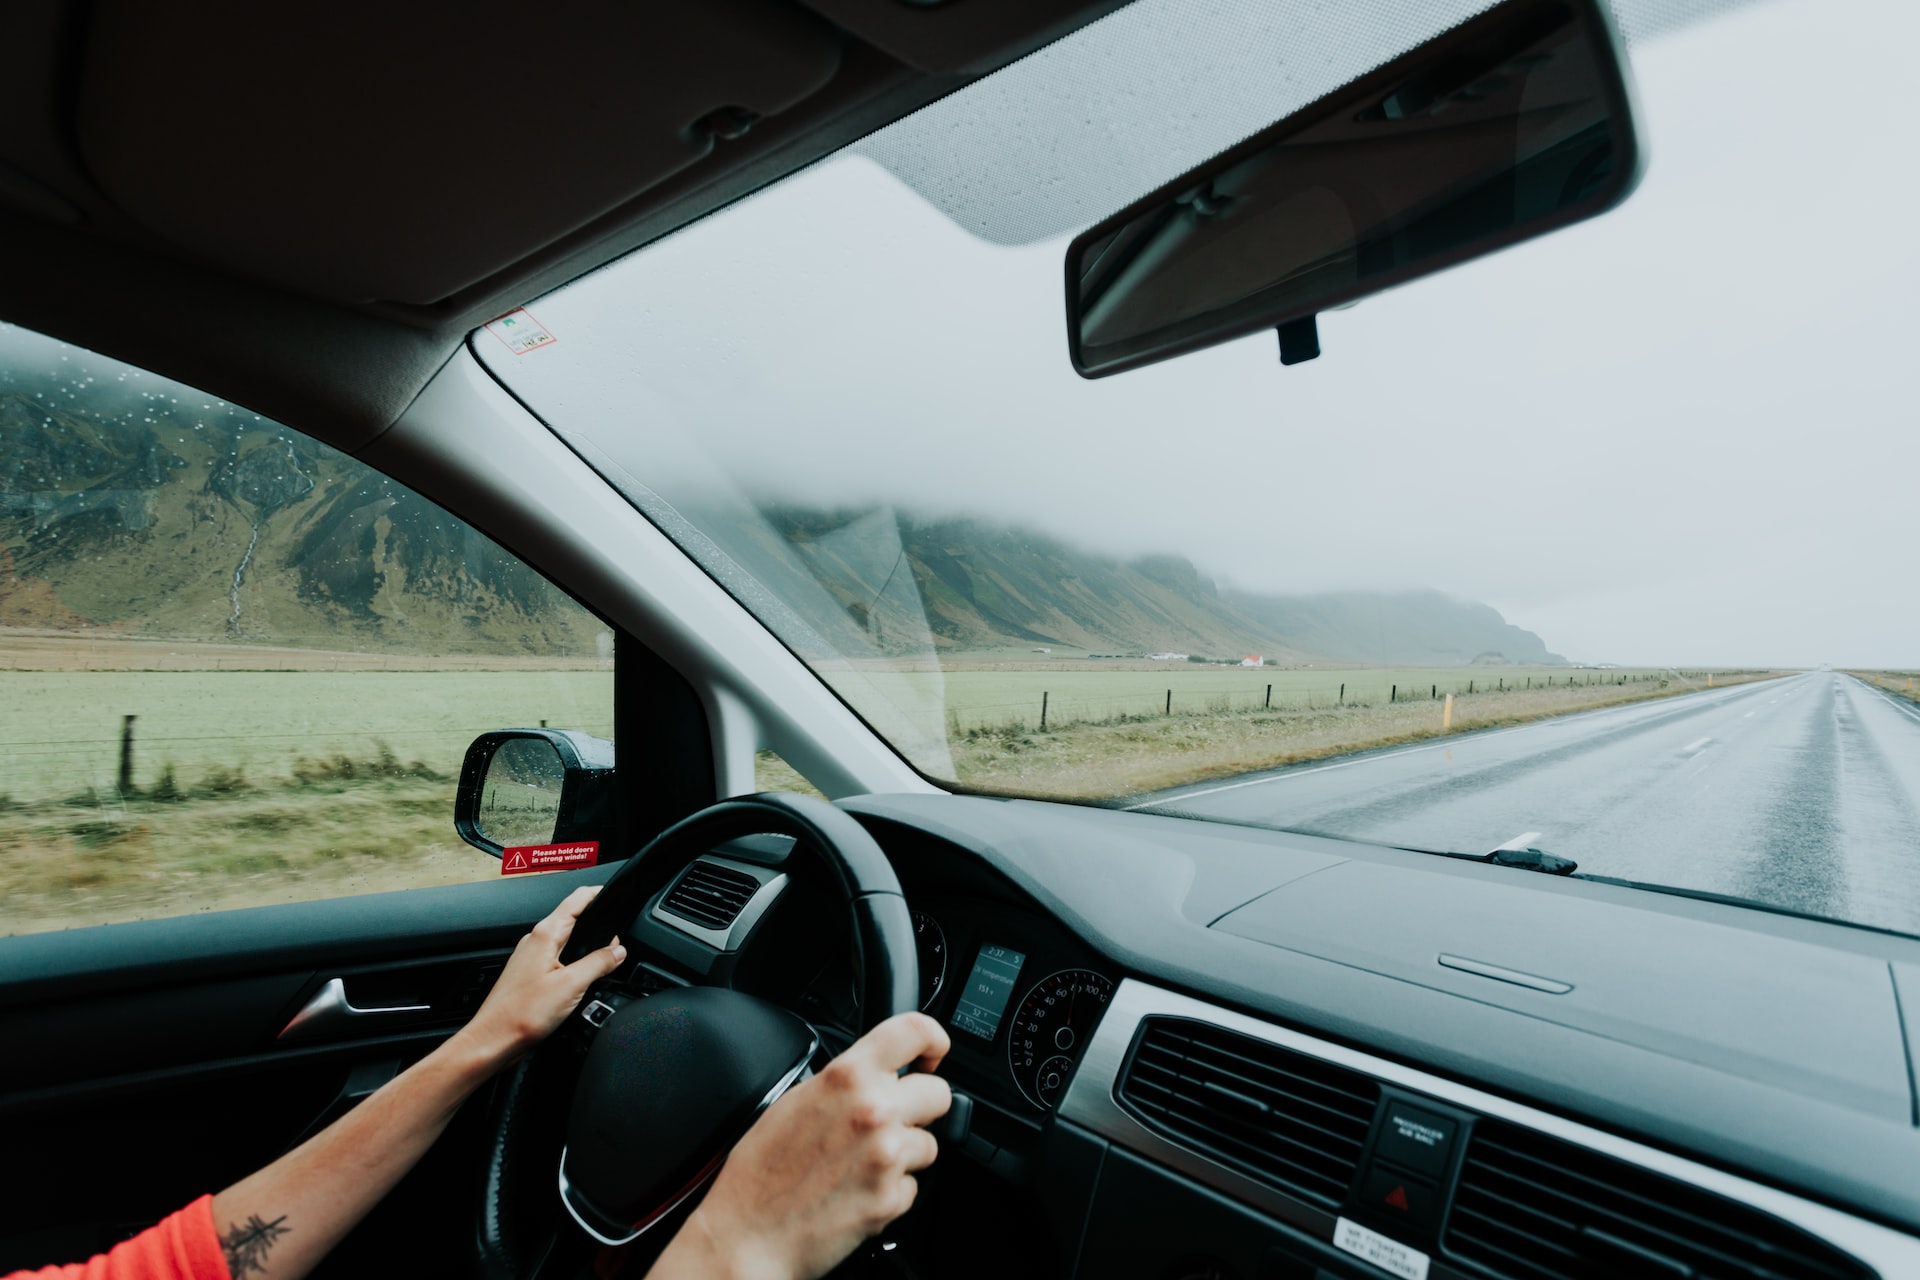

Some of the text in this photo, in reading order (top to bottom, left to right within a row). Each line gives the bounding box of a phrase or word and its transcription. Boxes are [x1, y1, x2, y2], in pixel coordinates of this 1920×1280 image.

[533, 846, 594, 857] Please hold doors
[540, 855, 562, 863] strong
[918, 924, 925, 933] 3
[934, 945, 941, 953] 4
[988, 947, 1005, 958] 2:37
[932, 976, 940, 985] 5
[1056, 988, 1067, 997] 60
[1085, 984, 1100, 995] 100
[1044, 996, 1055, 1006] 40
[1034, 1008, 1045, 1018] 30
[1027, 1023, 1038, 1032] 20
[1023, 1039, 1033, 1049] 10
[1025, 1058, 1032, 1066] 0
